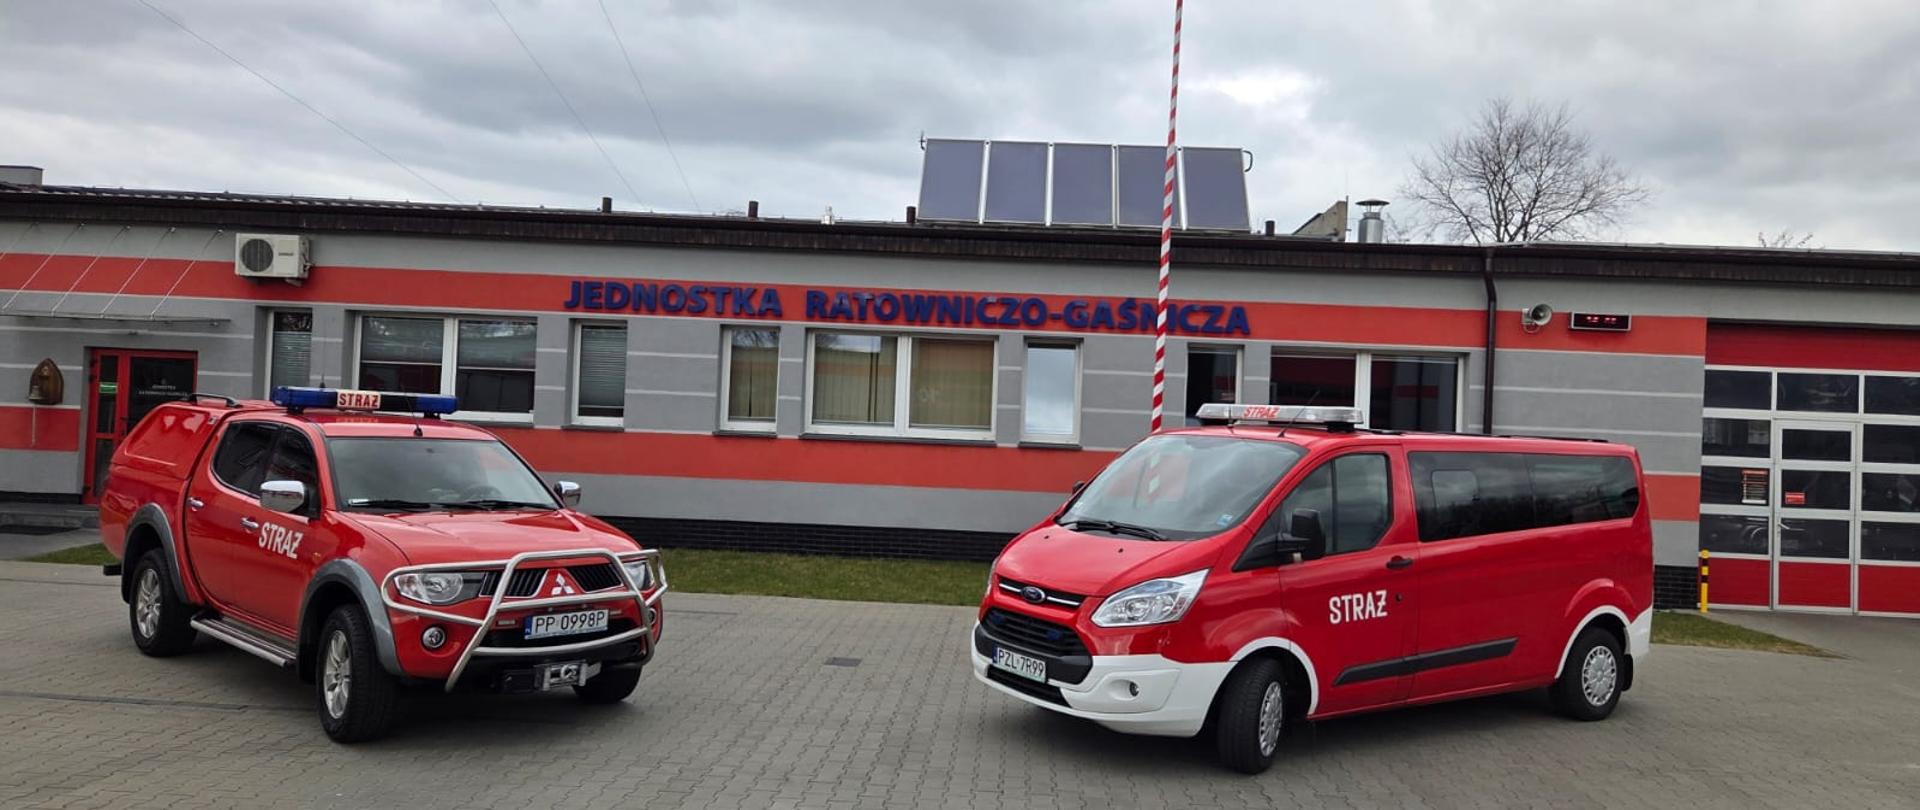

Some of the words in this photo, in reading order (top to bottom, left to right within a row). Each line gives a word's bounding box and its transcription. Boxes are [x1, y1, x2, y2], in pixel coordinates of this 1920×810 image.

[564, 280, 782, 317] JEDNOSTKA
[806, 290, 1250, 335] RATOWNICZO-GAŚNICZA
[535, 616, 556, 633] PP
[560, 610, 605, 630] 0998P
[999, 650, 1017, 669] PZL
[1020, 656, 1045, 677] 7R99
